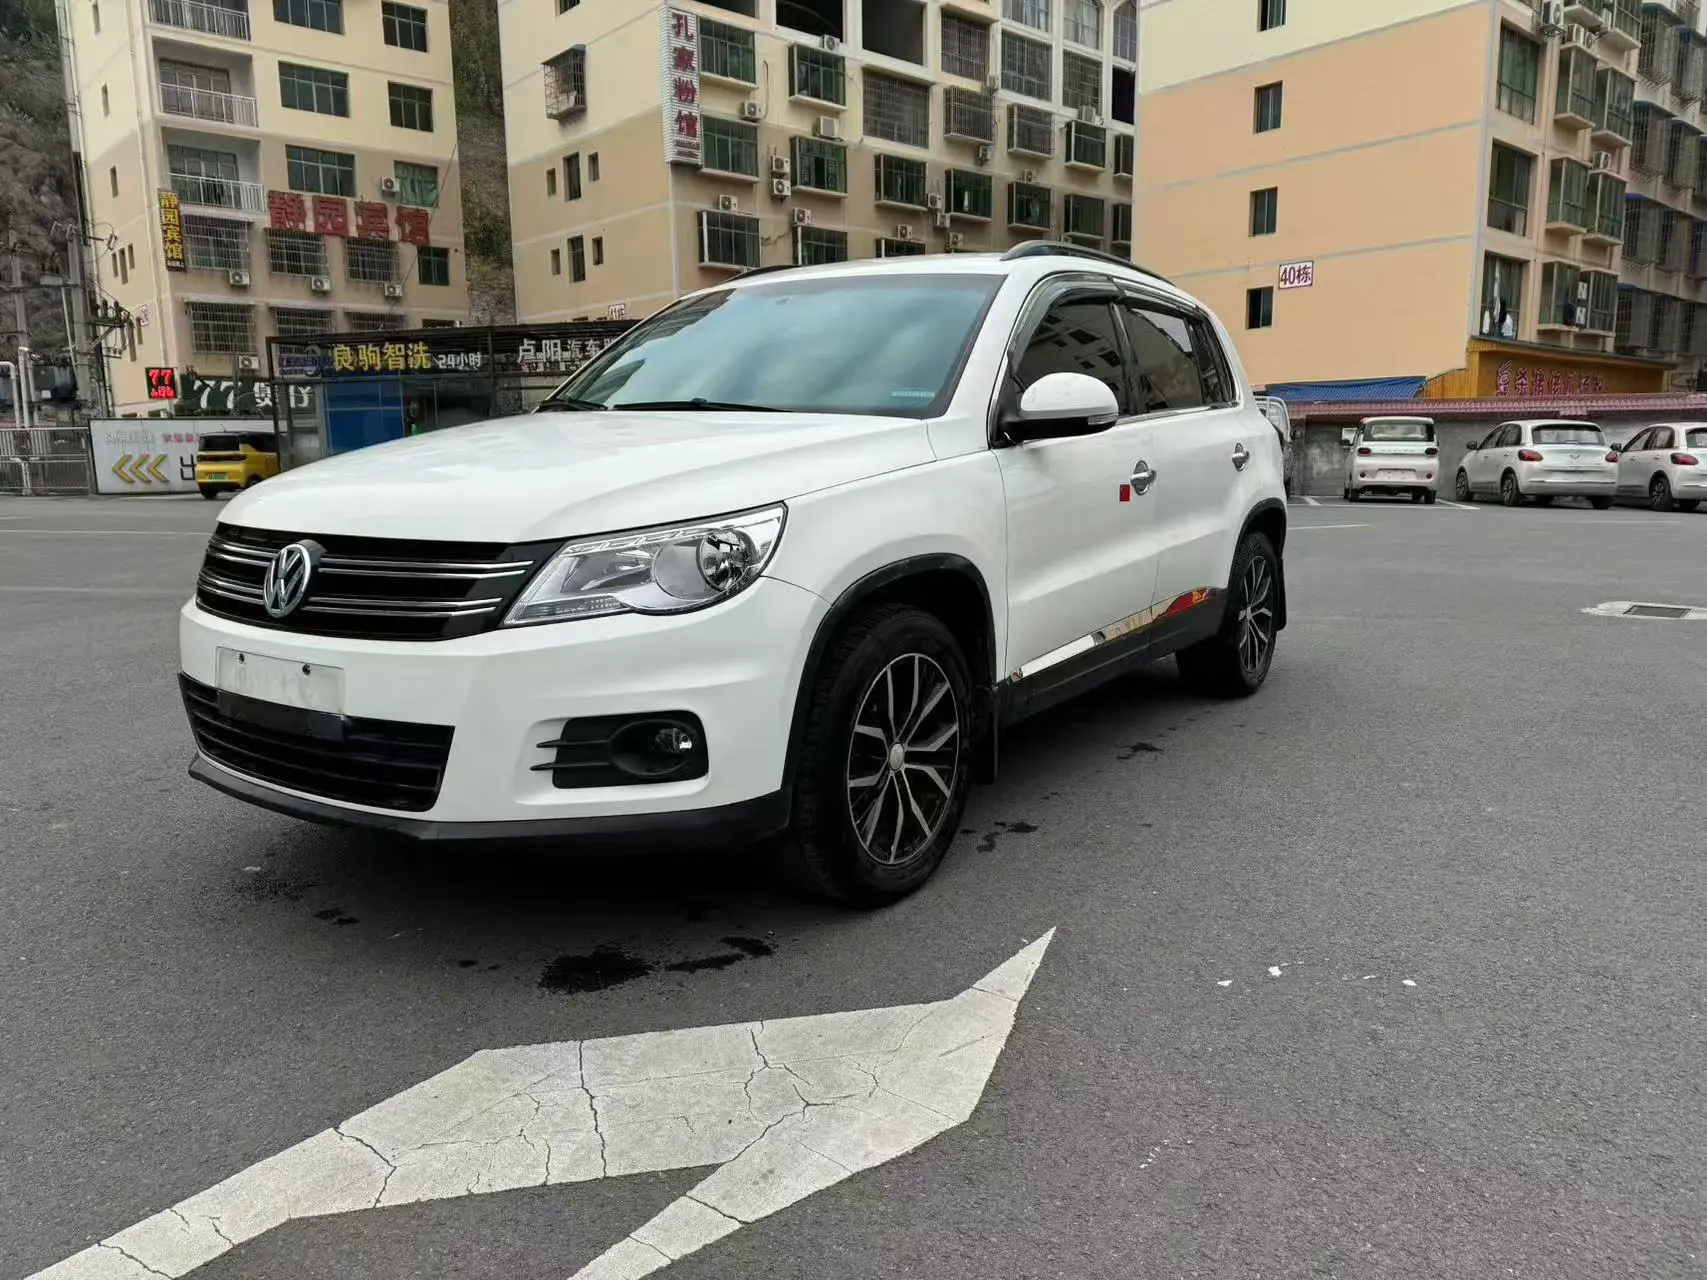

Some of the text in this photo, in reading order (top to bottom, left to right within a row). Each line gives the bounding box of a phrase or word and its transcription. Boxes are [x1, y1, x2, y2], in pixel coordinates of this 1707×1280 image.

[160, 192, 183, 259] 静园宾馆
[1280, 264, 1311, 285] 40栋
[333, 343, 431, 372] 良驹智洗
[437, 352, 482, 370] 24小时
[149, 369, 172, 385] 77
